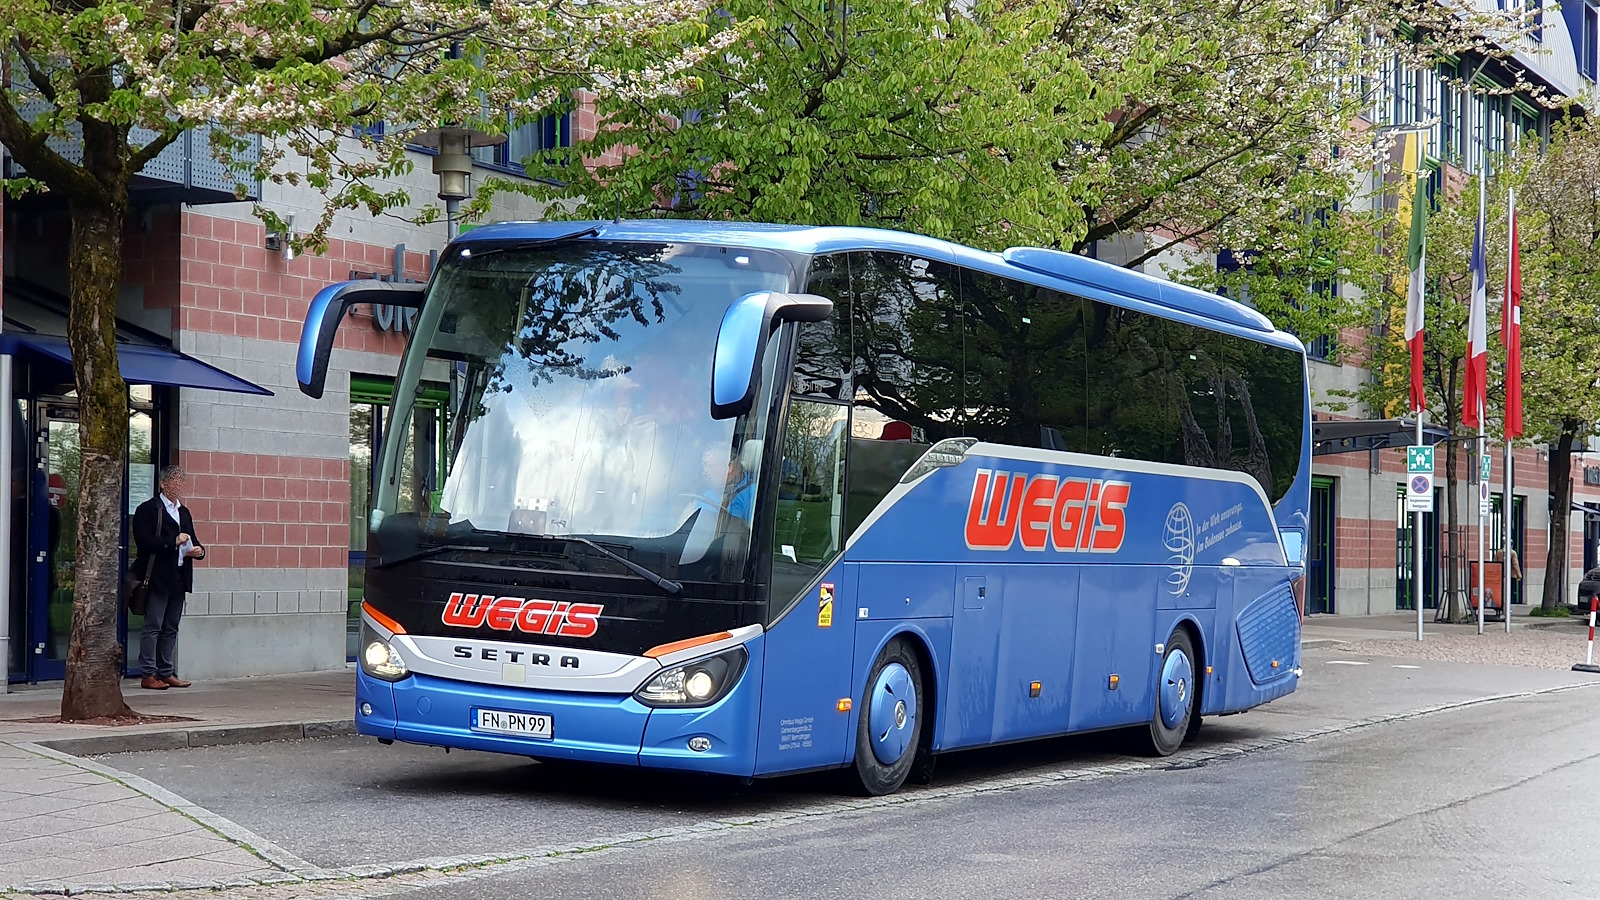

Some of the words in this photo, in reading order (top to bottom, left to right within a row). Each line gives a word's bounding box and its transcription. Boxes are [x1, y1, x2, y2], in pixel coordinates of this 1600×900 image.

[453, 645, 580, 669] SETRA
[482, 712, 500, 728] FN
[508, 714, 526, 731] PN
[528, 717, 546, 732] 99
